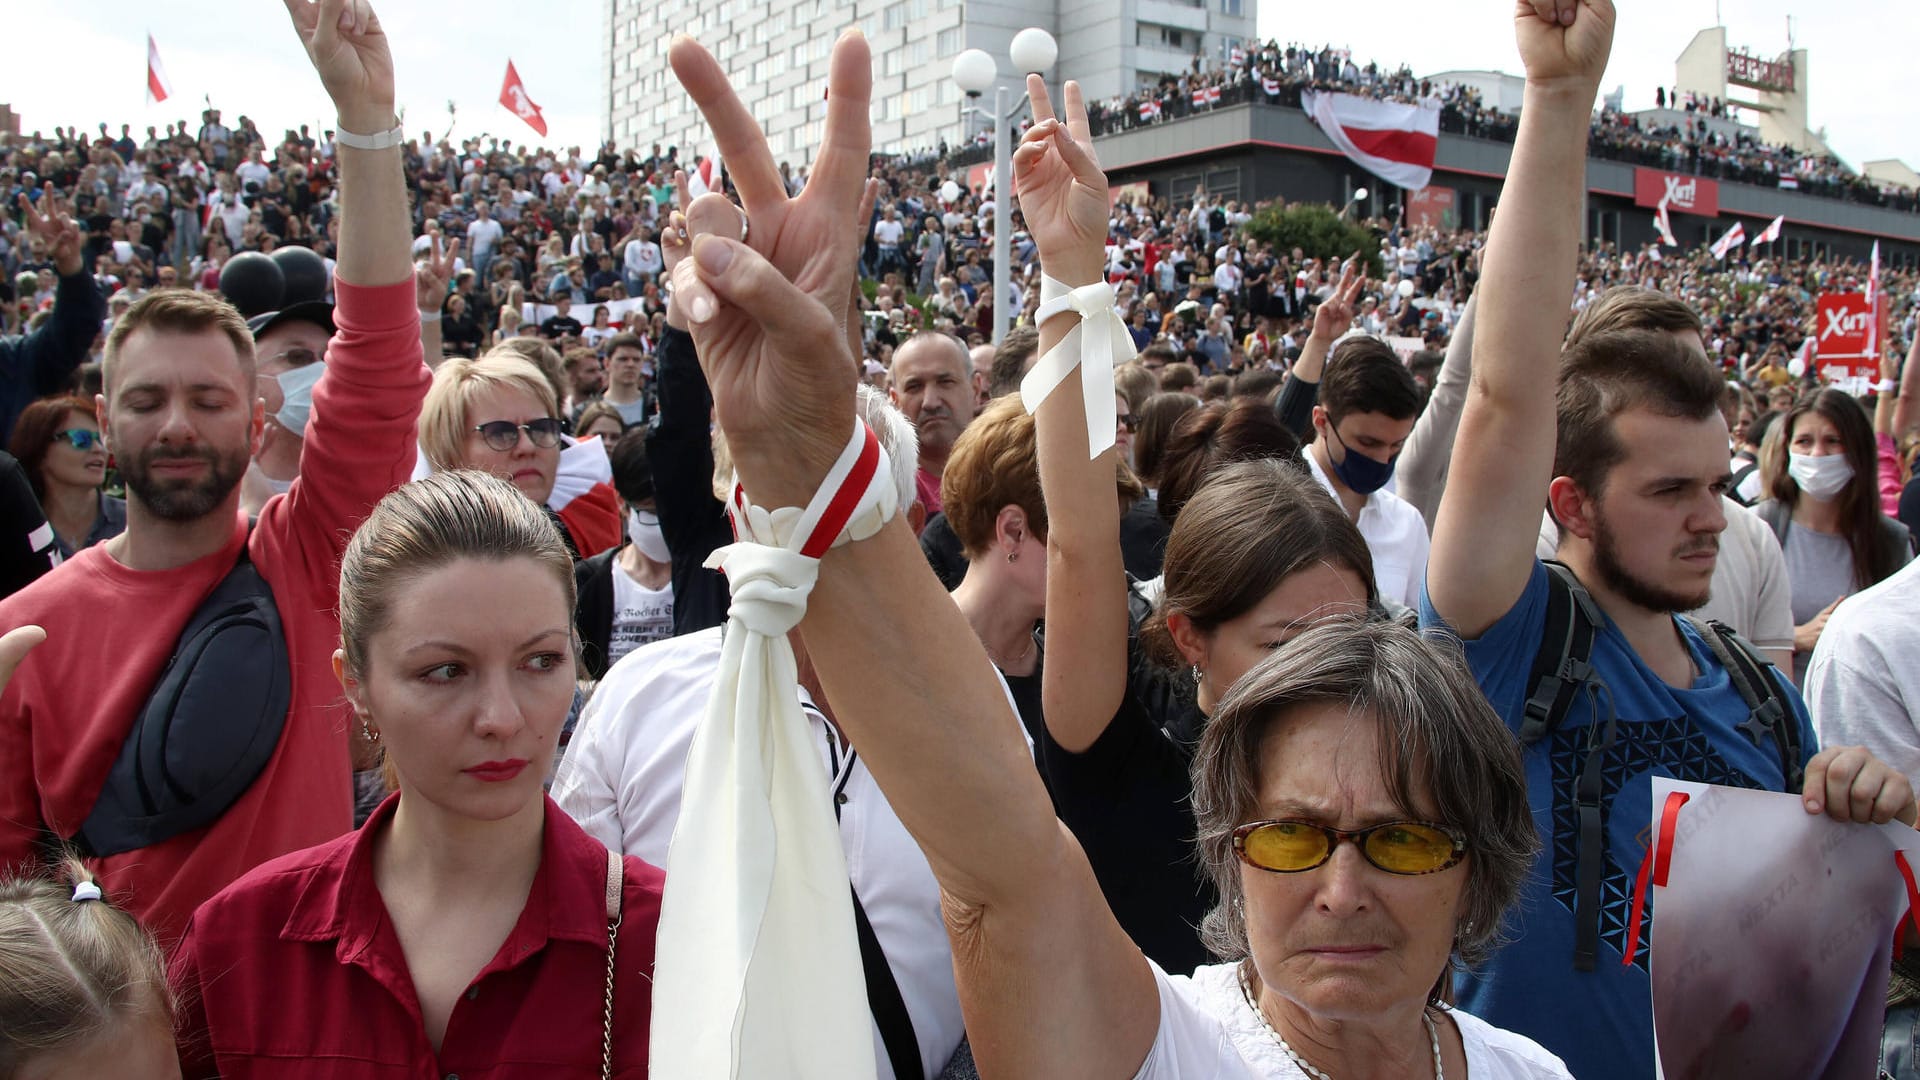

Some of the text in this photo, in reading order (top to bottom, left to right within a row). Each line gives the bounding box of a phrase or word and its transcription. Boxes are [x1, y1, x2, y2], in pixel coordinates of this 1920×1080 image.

[1820, 306, 1868, 341] Хит
[1739, 873, 1800, 937] NEXTA
[1819, 904, 1886, 963] NEXTA
